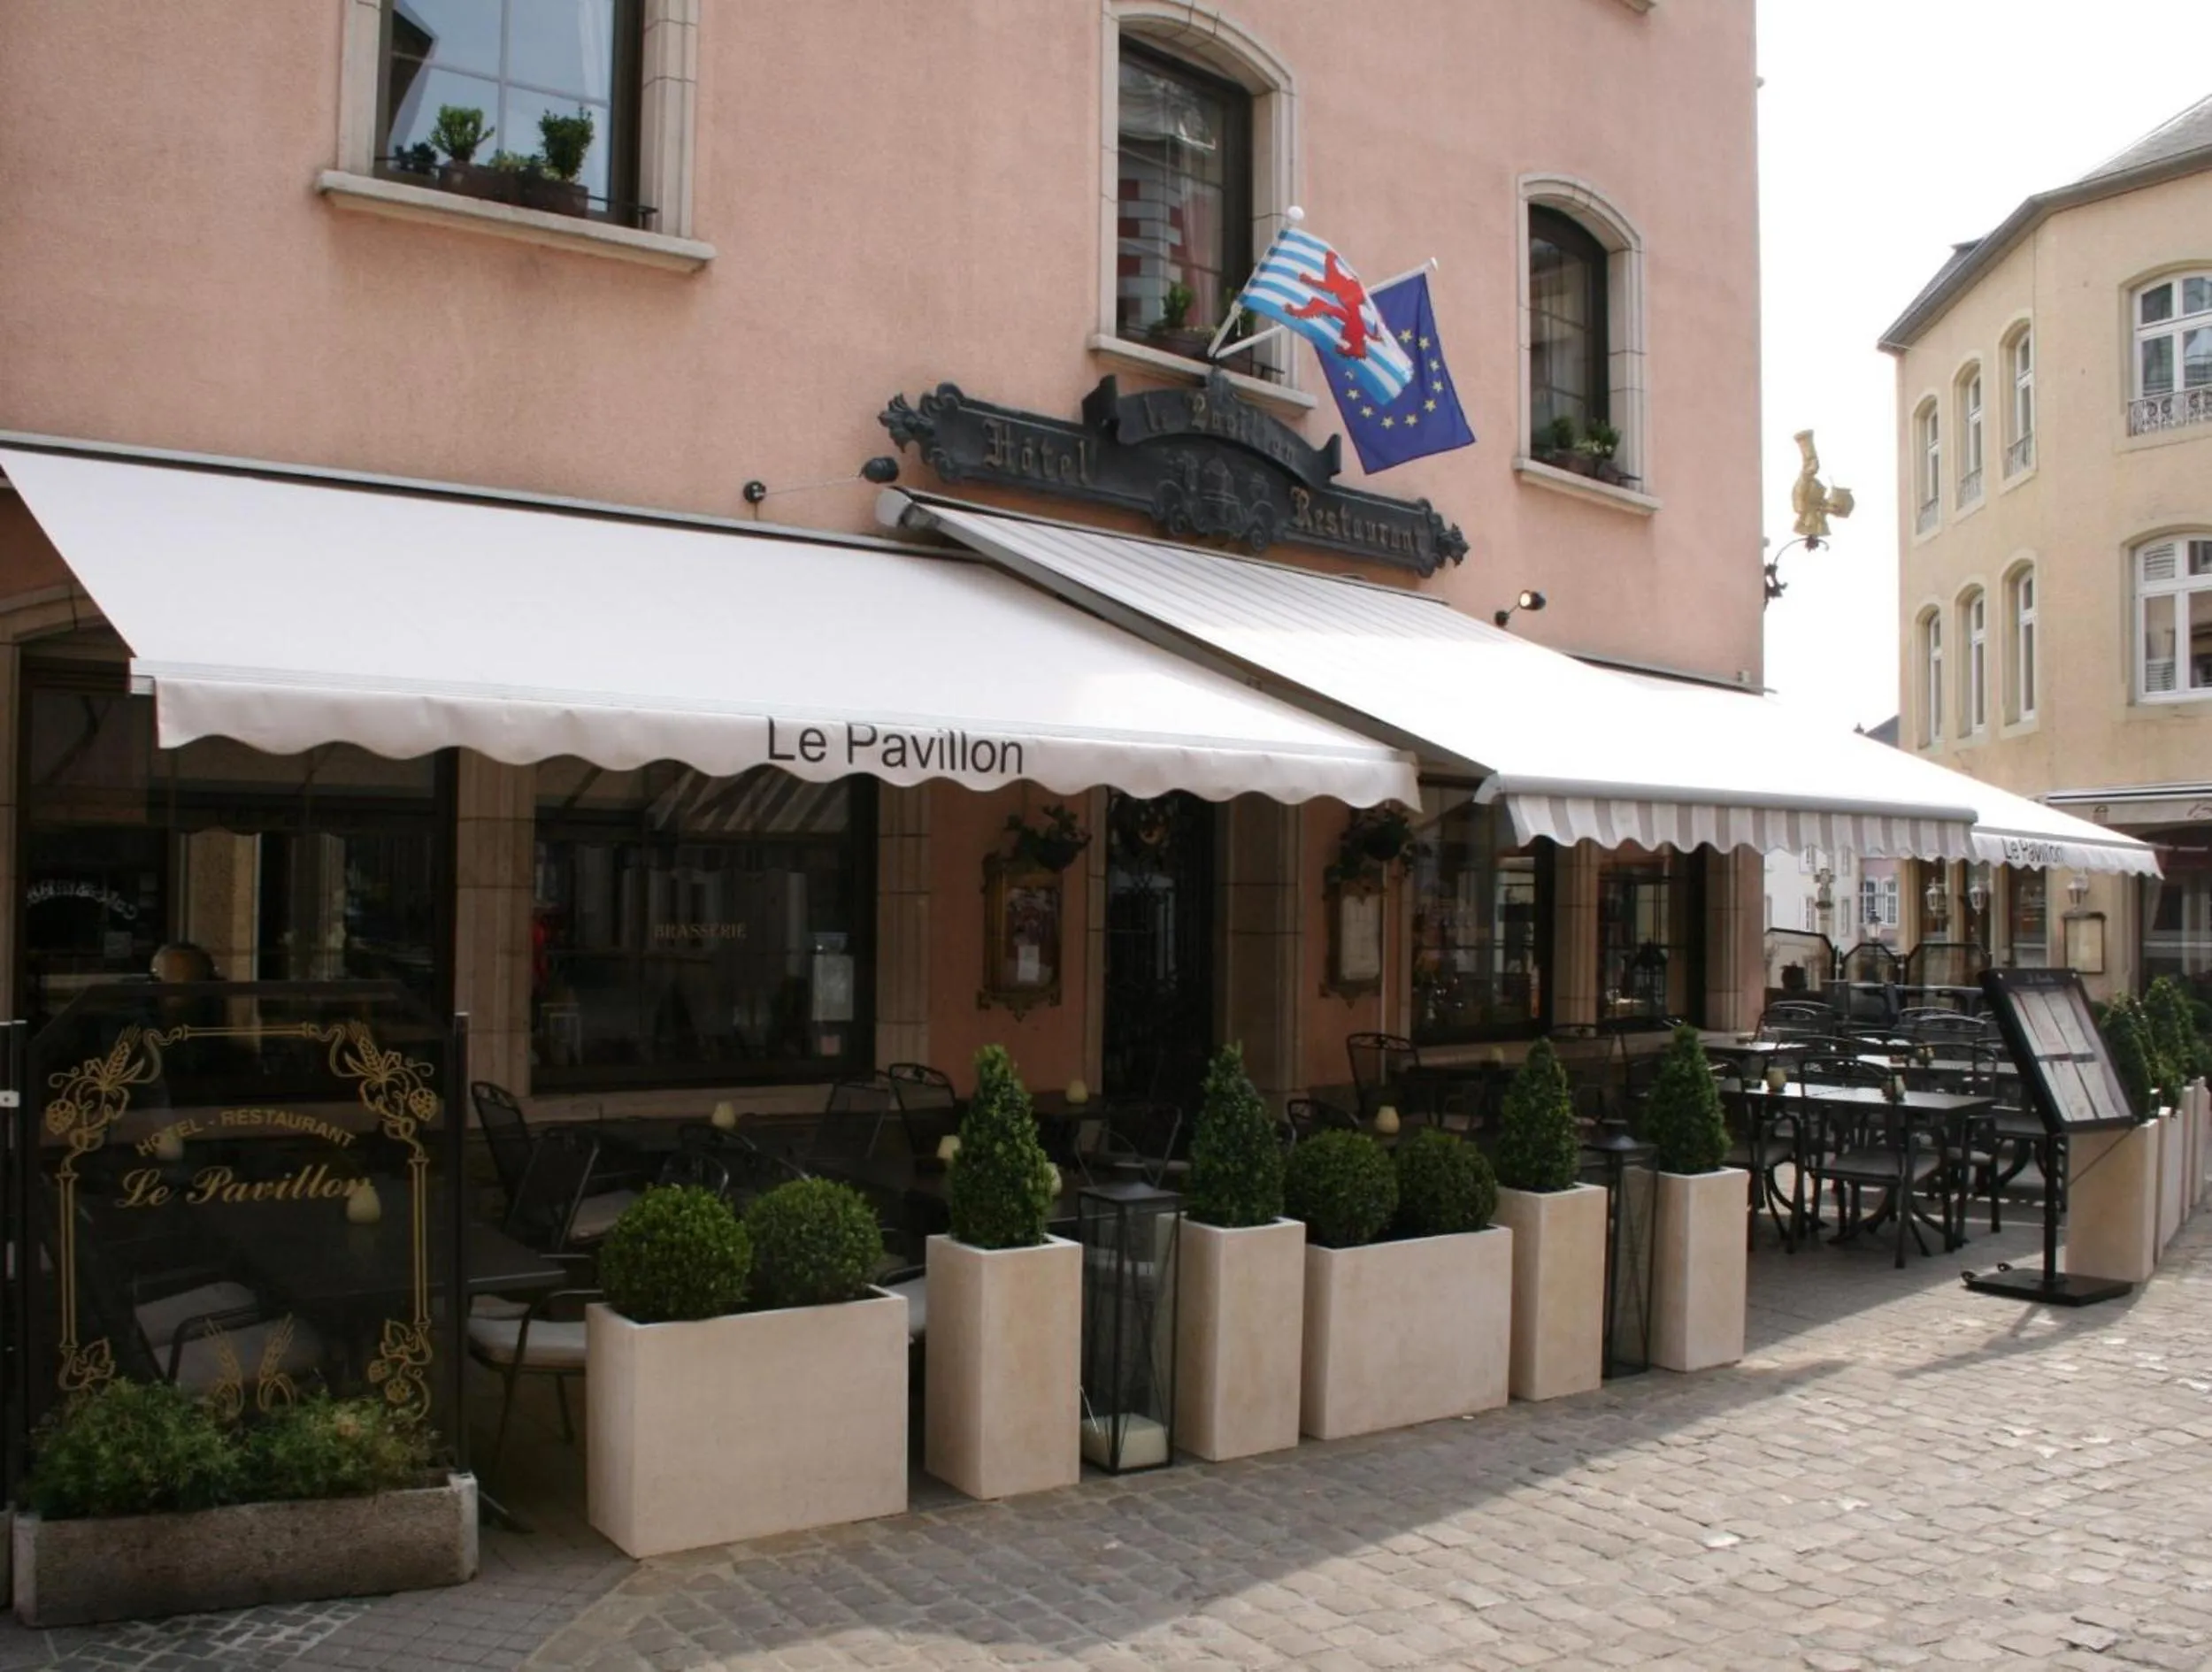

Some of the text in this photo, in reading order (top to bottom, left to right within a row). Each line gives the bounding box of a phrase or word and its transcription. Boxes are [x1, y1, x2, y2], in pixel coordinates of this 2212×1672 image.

[767, 716, 1023, 775] Le Pavillon
[2001, 840, 2064, 863] Le Pavillon
[653, 922, 749, 939] BRASSERIE
[135, 1118, 204, 1156] HOTEL
[220, 1108, 357, 1148] RESTAURANT
[114, 1163, 372, 1208] Le Pavillon
